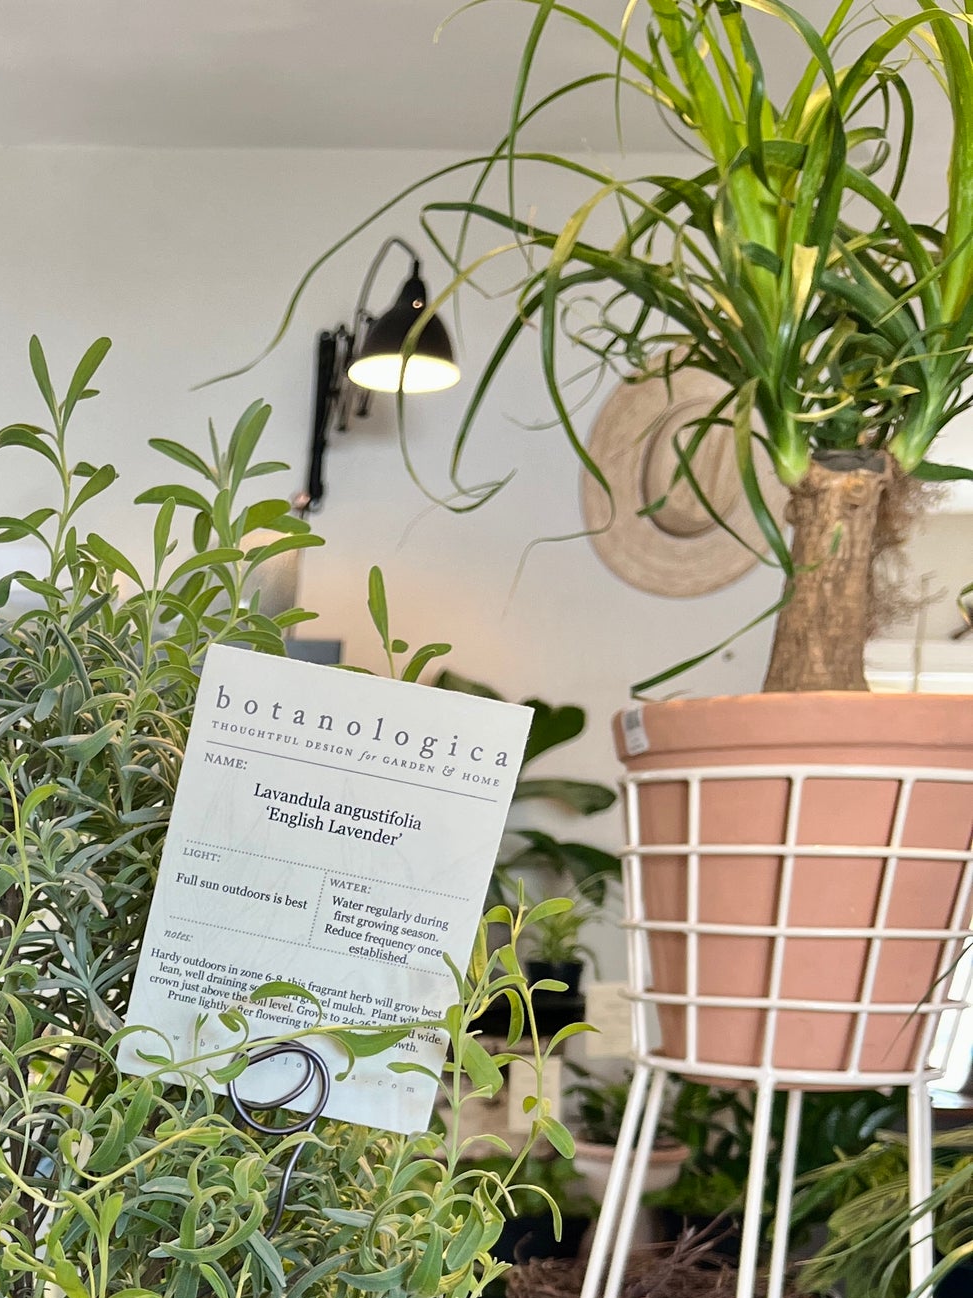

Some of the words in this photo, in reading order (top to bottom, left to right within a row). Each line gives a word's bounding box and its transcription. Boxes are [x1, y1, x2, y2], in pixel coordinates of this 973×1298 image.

[216, 685, 508, 767] botanologica
[204, 752, 248, 770] NAME:
[211, 720, 299, 746] THOUGHTFUL
[305, 740, 354, 756] DESIGN
[358, 750, 377, 761] for
[382, 756, 436, 773] GARDEN
[442, 765, 455, 777] &
[462, 772, 500, 787] HOME
[253, 783, 331, 811] Lavandula
[334, 803, 422, 830] angustifolia
[182, 847, 221, 863] LIGHT:
[175, 872, 198, 886] Full
[199, 879, 220, 891] sun
[222, 884, 271, 902] outdoors
[273, 892, 283, 904] is
[285, 894, 308, 910] best
[329, 878, 372, 894] WATER:
[331, 896, 364, 911] Water
[365, 904, 413, 924] regularly
[413, 912, 449, 931] during
[333, 910, 355, 925] first
[357, 917, 400, 935] growing
[401, 926, 439, 942] season.
[163, 928, 194, 942] notes:
[324, 924, 362, 941] Reduce
[364, 931, 415, 952] frequency
[417, 945, 443, 958] once
[348, 944, 409, 965] established.
[150, 947, 182, 964] Hardy
[183, 955, 227, 972] outdoors
[227, 964, 238, 975] in
[239, 968, 263, 980] zone
[307, 981, 348, 998] fragrant
[349, 989, 373, 1004] herb
[374, 997, 393, 1008] will
[393, 1002, 420, 1013] grow
[421, 1005, 442, 1018] best
[159, 962, 183, 977] lean,
[184, 969, 205, 981] well
[206, 973, 248, 991] draining
[149, 974, 180, 988] crown
[179, 980, 200, 993] just
[201, 985, 231, 998] above
[232, 991, 248, 1002] the
[268, 998, 294, 1013] level.
[329, 1013, 340, 1023] to
[167, 989, 197, 1005] Prune
[198, 996, 230, 1013] lightly
[235, 1004, 255, 1016] fter
[255, 1008, 302, 1029] flowering
[332, 1001, 366, 1016] mulch.
[371, 1008, 397, 1022] Plant
[417, 1031, 443, 1045] wide.
